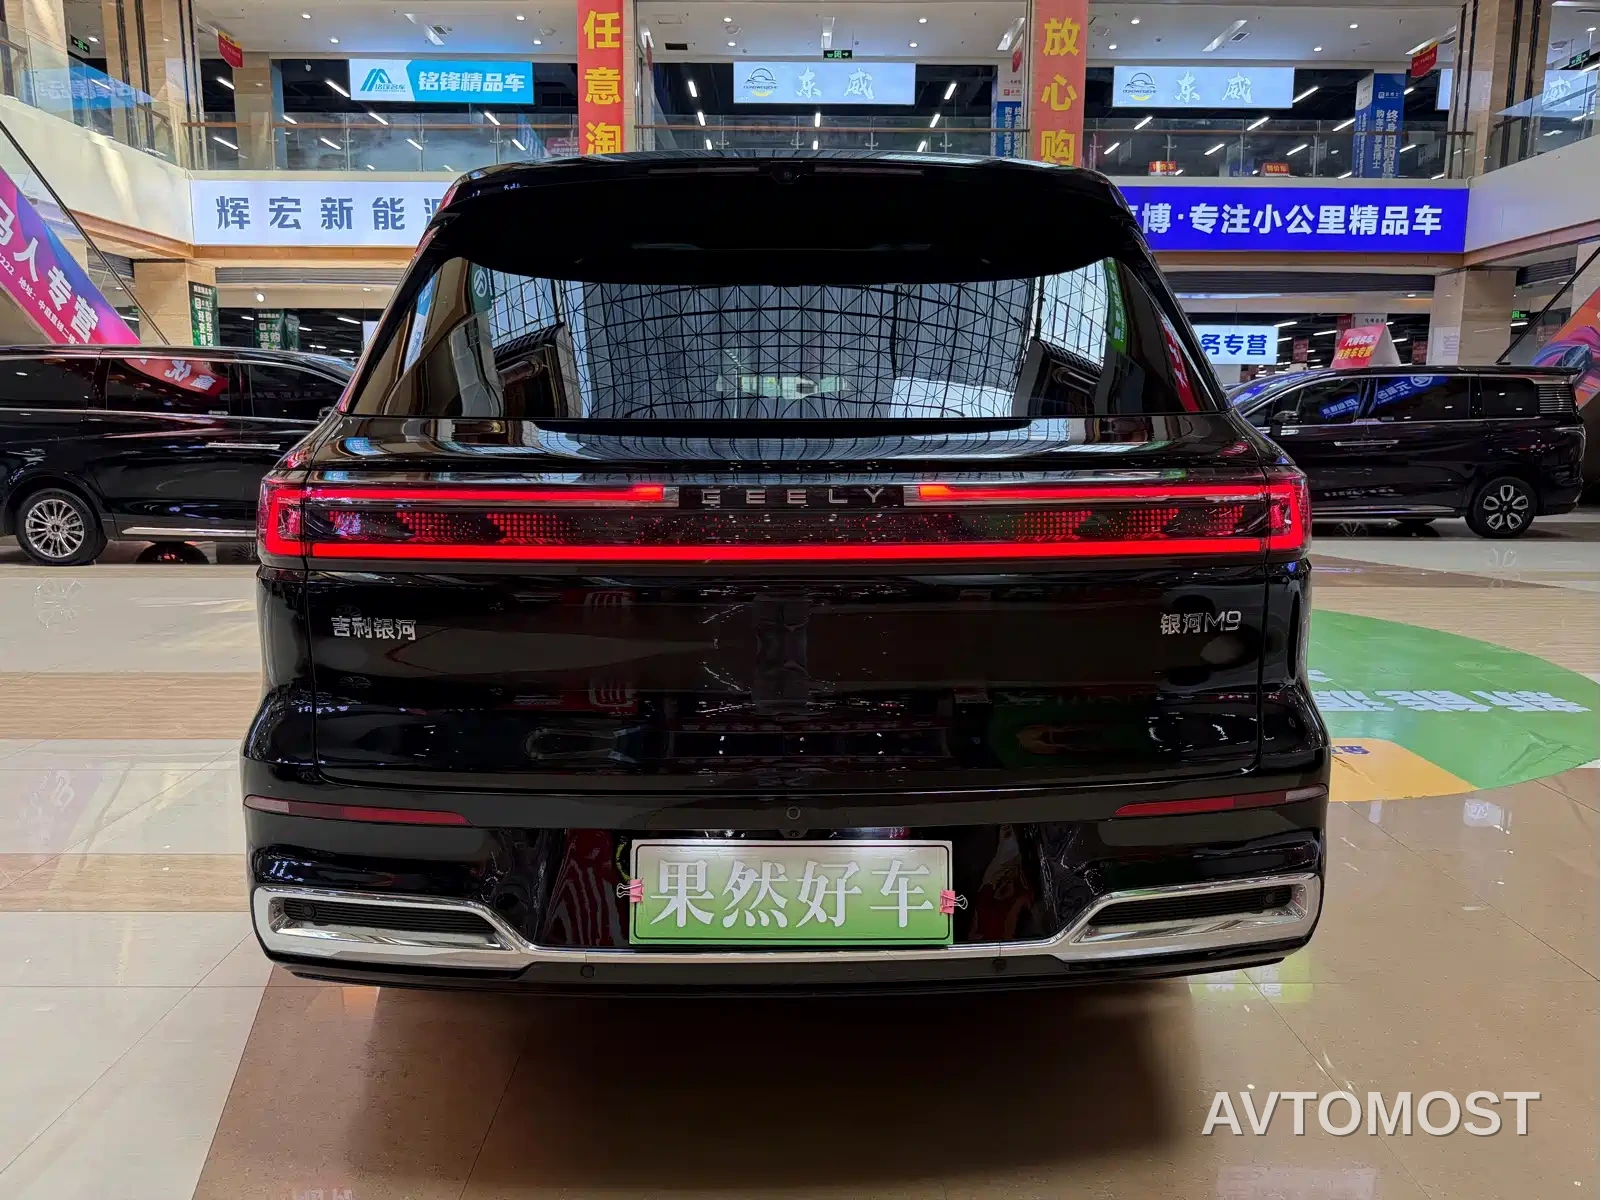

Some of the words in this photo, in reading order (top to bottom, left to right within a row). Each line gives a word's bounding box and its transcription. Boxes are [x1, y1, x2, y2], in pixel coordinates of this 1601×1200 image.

[418, 71, 525, 93] 铭锋精品车
[583, 10, 621, 154] 任意淘
[795, 66, 876, 101] 东威
[1041, 17, 1080, 165] 放心购
[1172, 70, 1254, 104] 东威
[1129, 202, 1442, 236] 博·专注小公里精品车
[1201, 334, 1267, 356] 务专营
[701, 488, 884, 504] GEELY
[331, 615, 417, 641] 吉利银河
[1160, 610, 1242, 635] 银河M9
[649, 859, 935, 929] 果然好车
